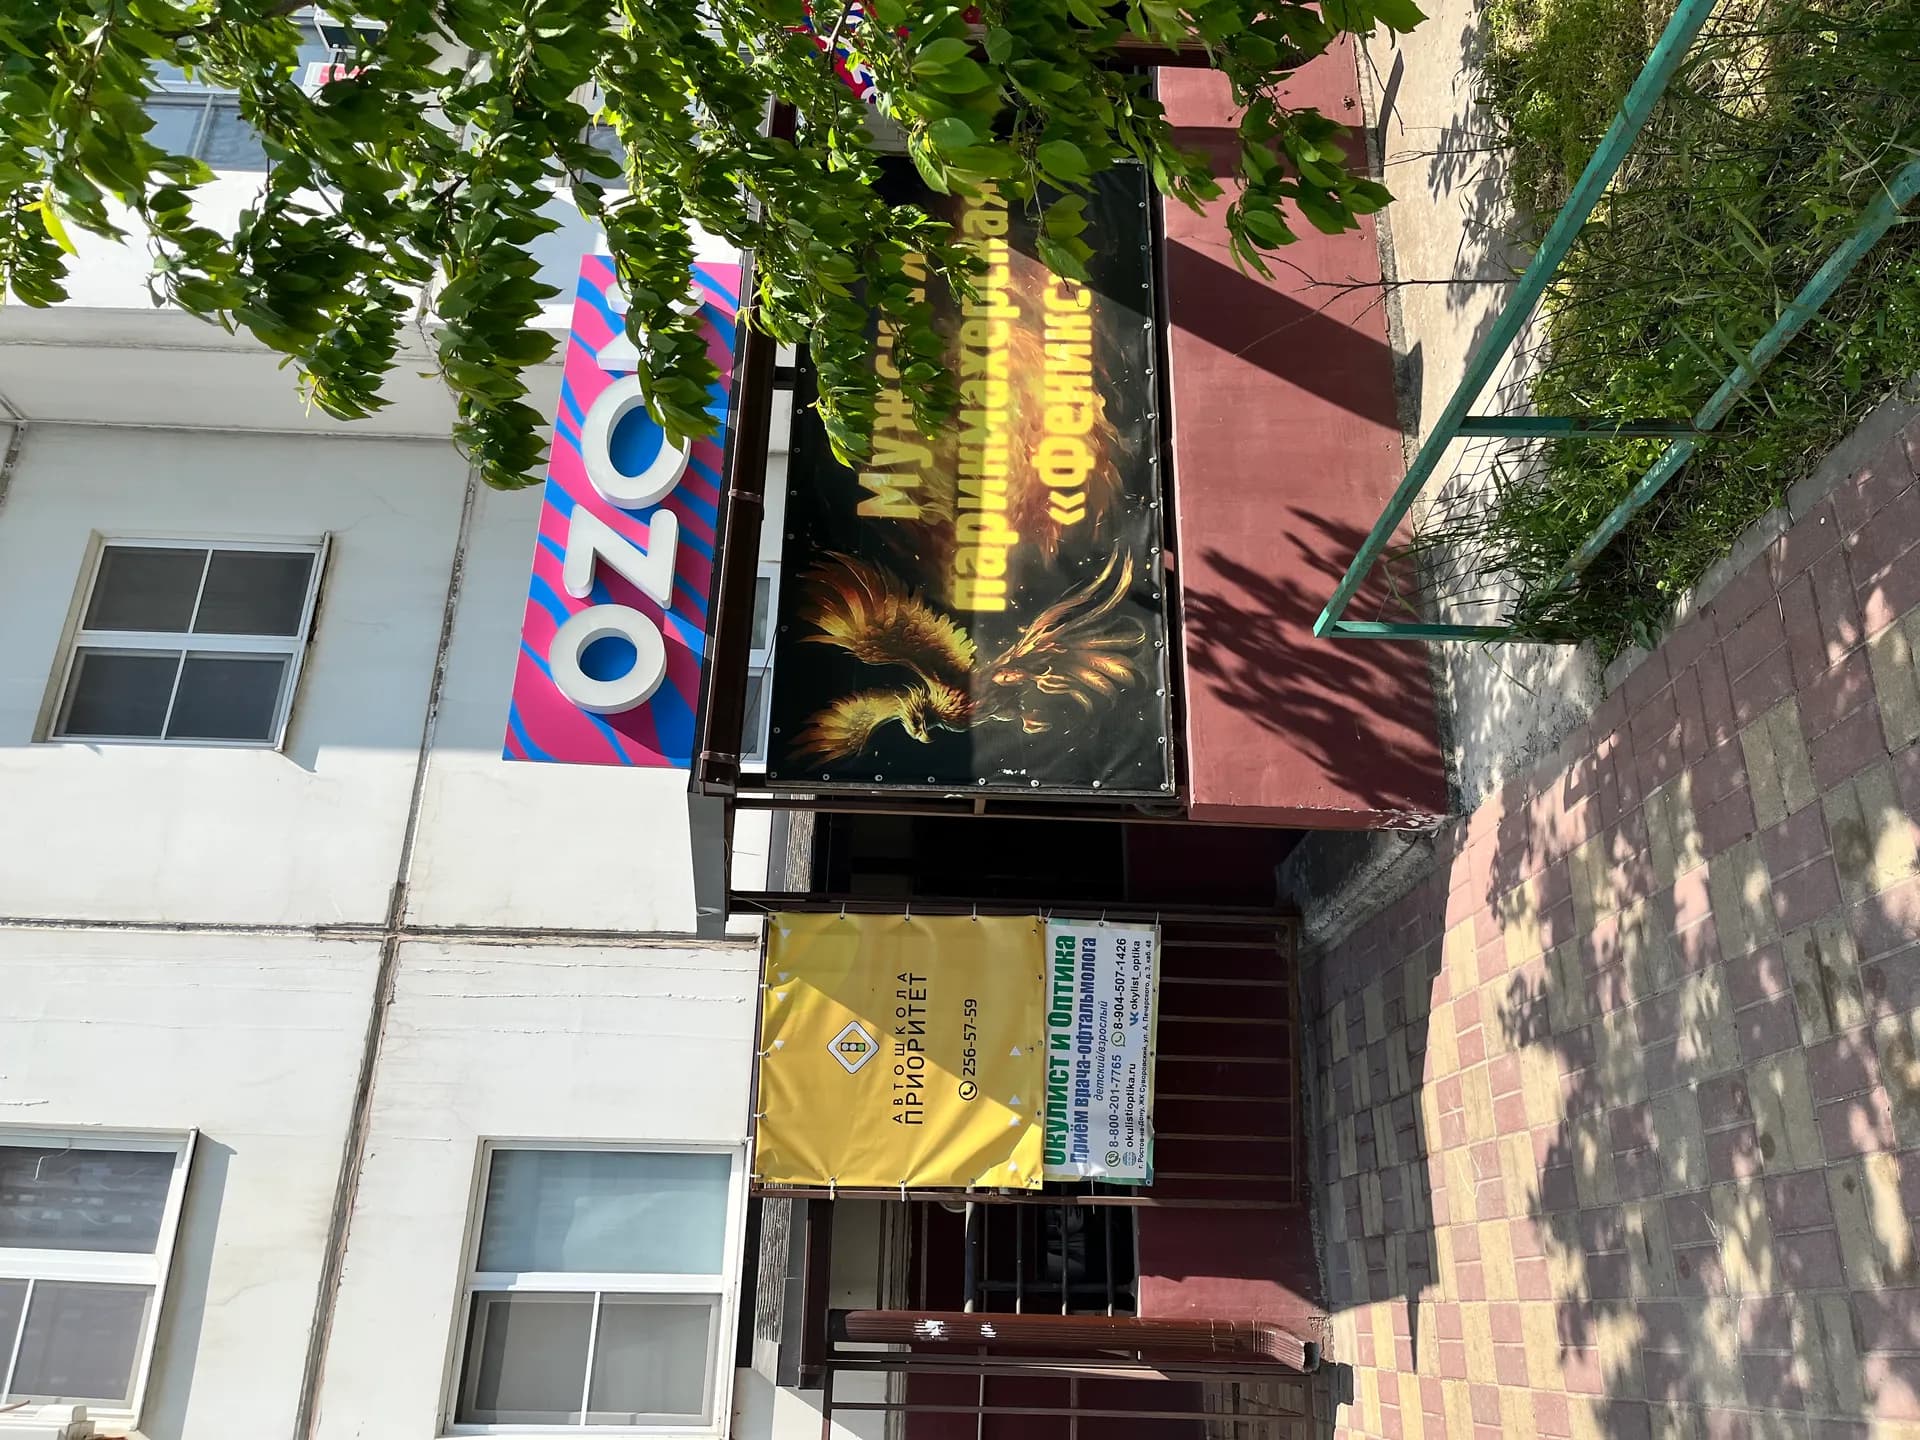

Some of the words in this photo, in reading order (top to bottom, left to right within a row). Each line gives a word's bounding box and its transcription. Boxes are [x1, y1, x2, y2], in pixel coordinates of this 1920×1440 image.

[1031, 273, 1095, 526] «Феникс
[1047, 935, 1075, 1028] Оптика
[1113, 938, 1127, 1030] 8-904-507-1426
[1130, 940, 1143, 1010] okylist_optika
[892, 972, 907, 1124] АВТОШКОЛА
[905, 972, 927, 1125] ПРИОРИТЕТ
[962, 999, 977, 1077] 256-57-59
[1050, 1034, 1071, 1051] и
[1074, 937, 1096, 1107] врача-офтальмолога
[1093, 1000, 1108, 1101] детский/взрослый
[1043, 1055, 1069, 1166] Окулист
[1069, 1111, 1090, 1164] Приём
[1108, 1054, 1122, 1148] 8-800-201-7765
[1124, 1063, 1137, 1148] okulistioptika.ru
